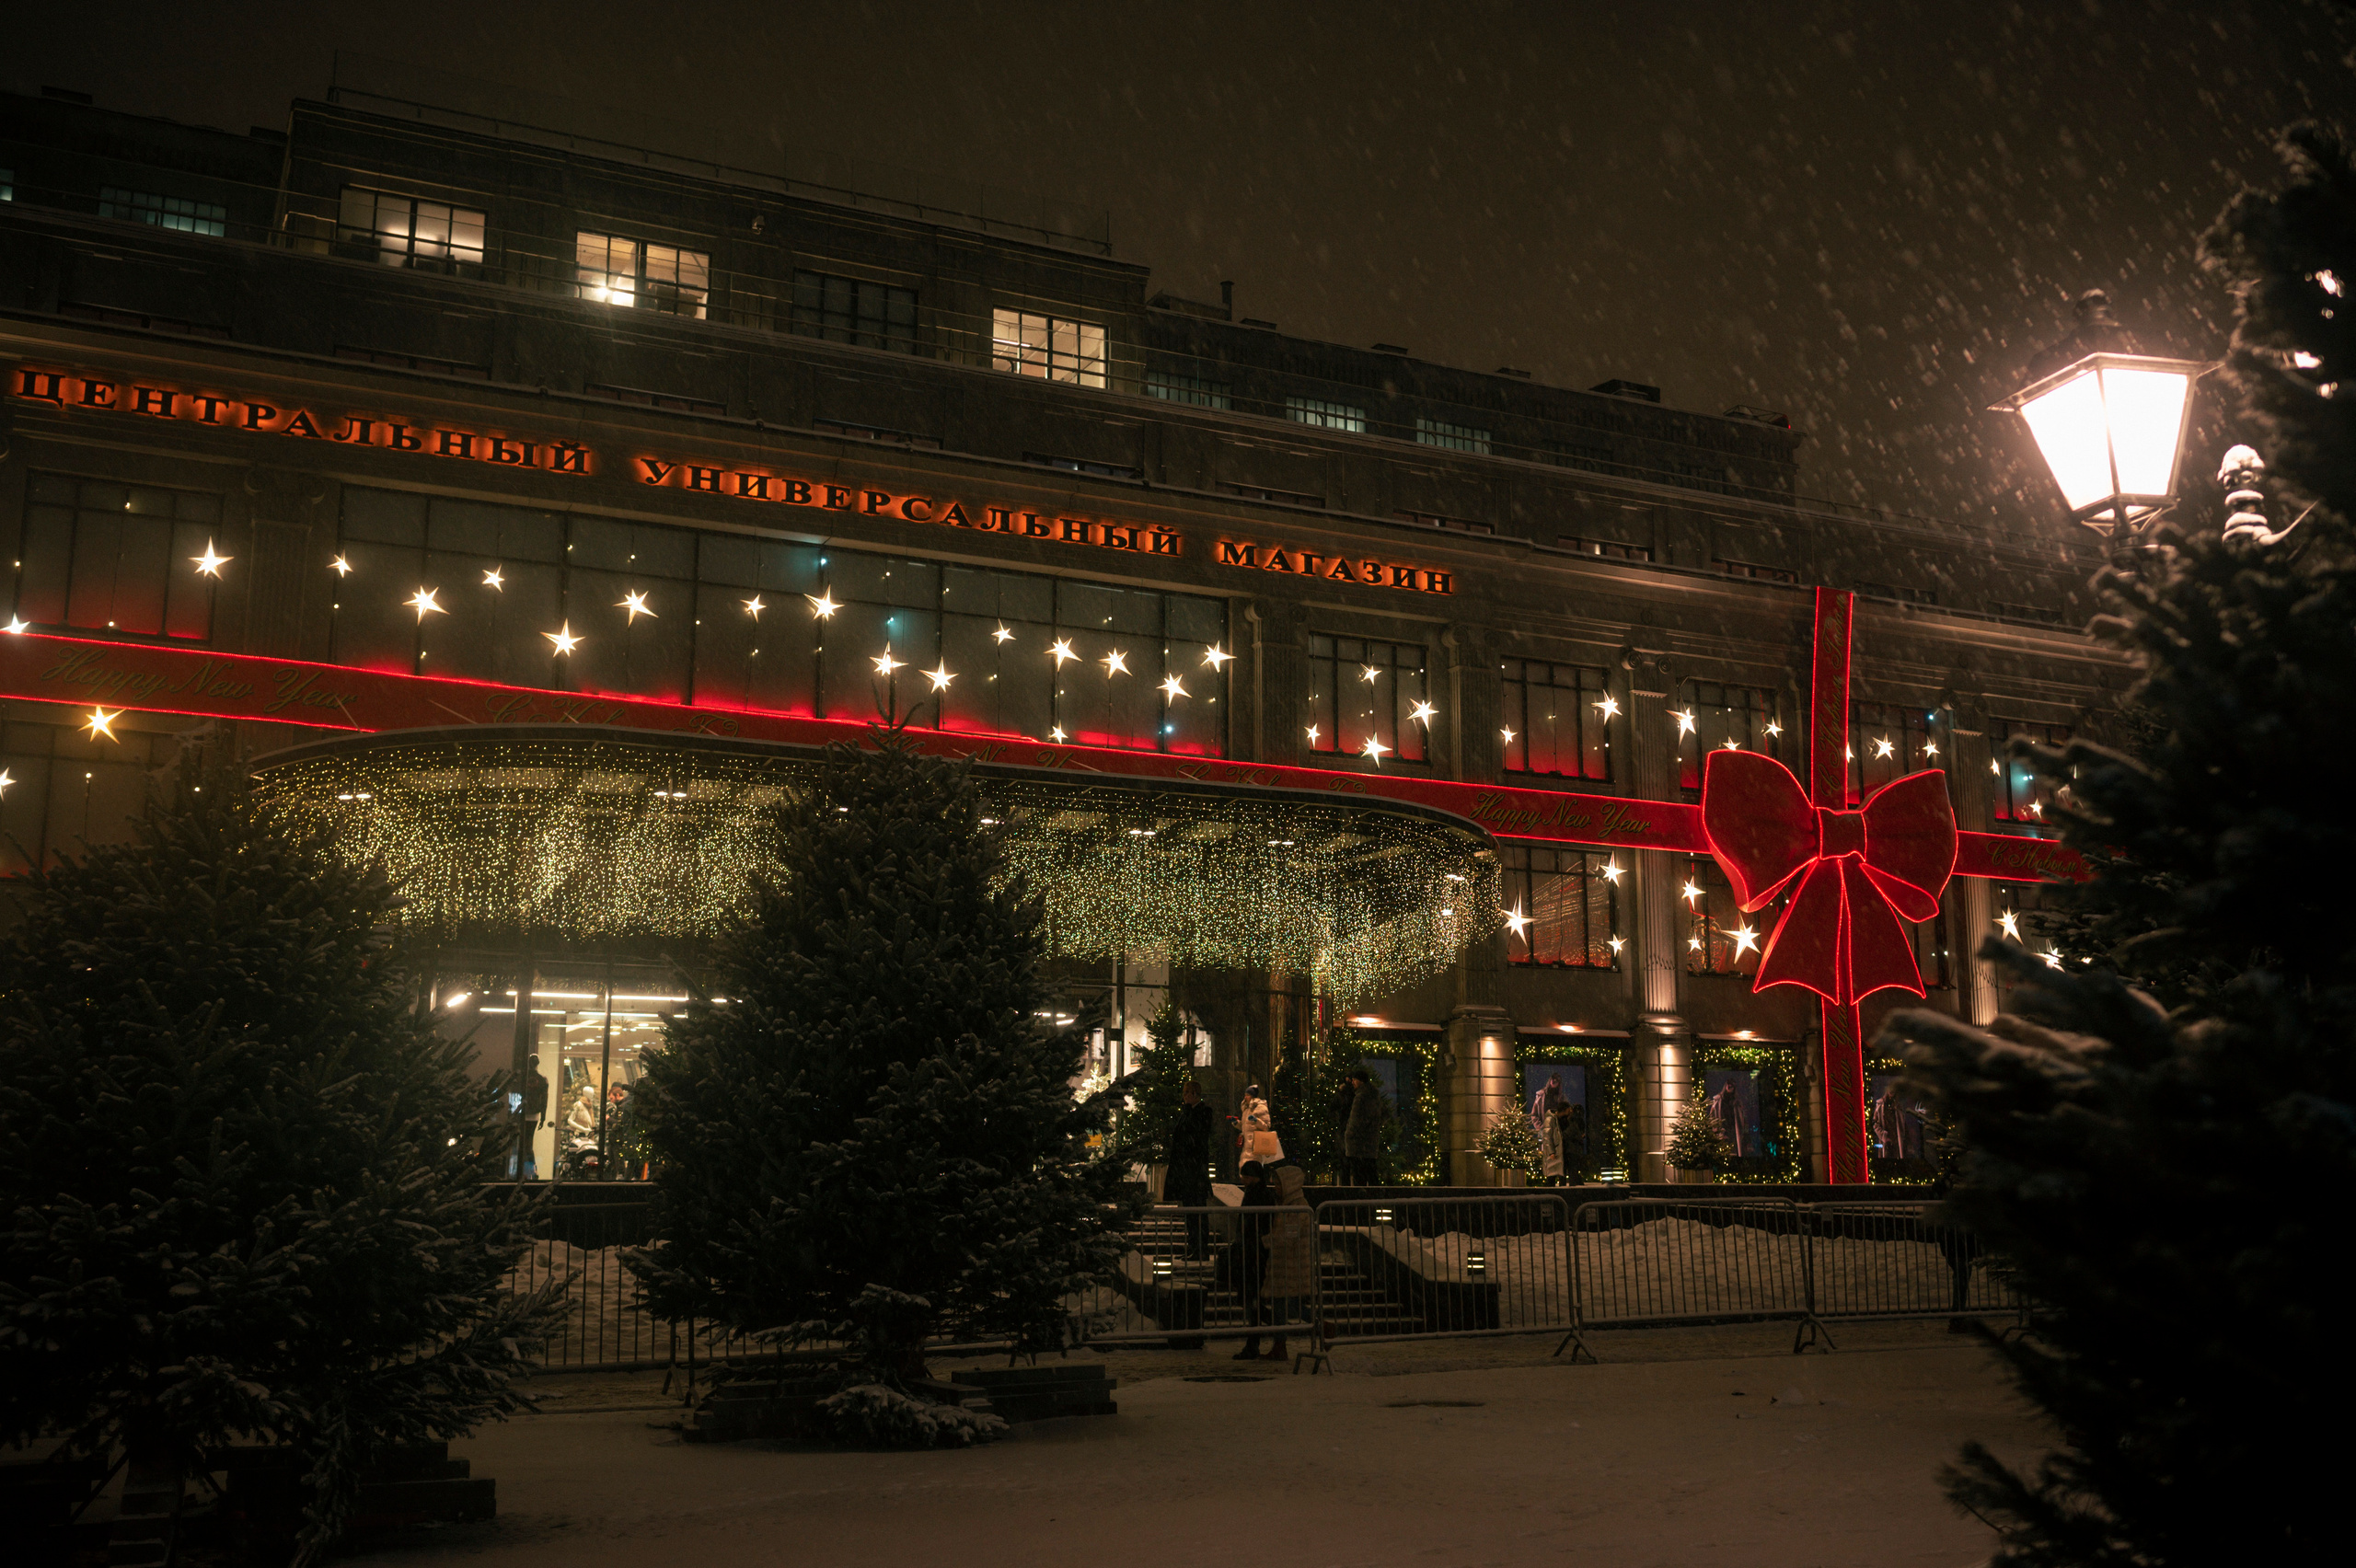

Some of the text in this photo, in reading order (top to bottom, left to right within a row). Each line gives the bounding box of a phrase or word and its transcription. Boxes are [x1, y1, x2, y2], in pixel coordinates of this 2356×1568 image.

[17, 369, 1454, 595] ЦЕНТРАЛЬНЫЙ УНИВЕРСАЛЬНЫЙ МАГАЗИН
[40, 646, 359, 714] Happy New Year
[1469, 791, 1652, 838] Happy New Year
[1830, 1059, 1854, 1112] New
